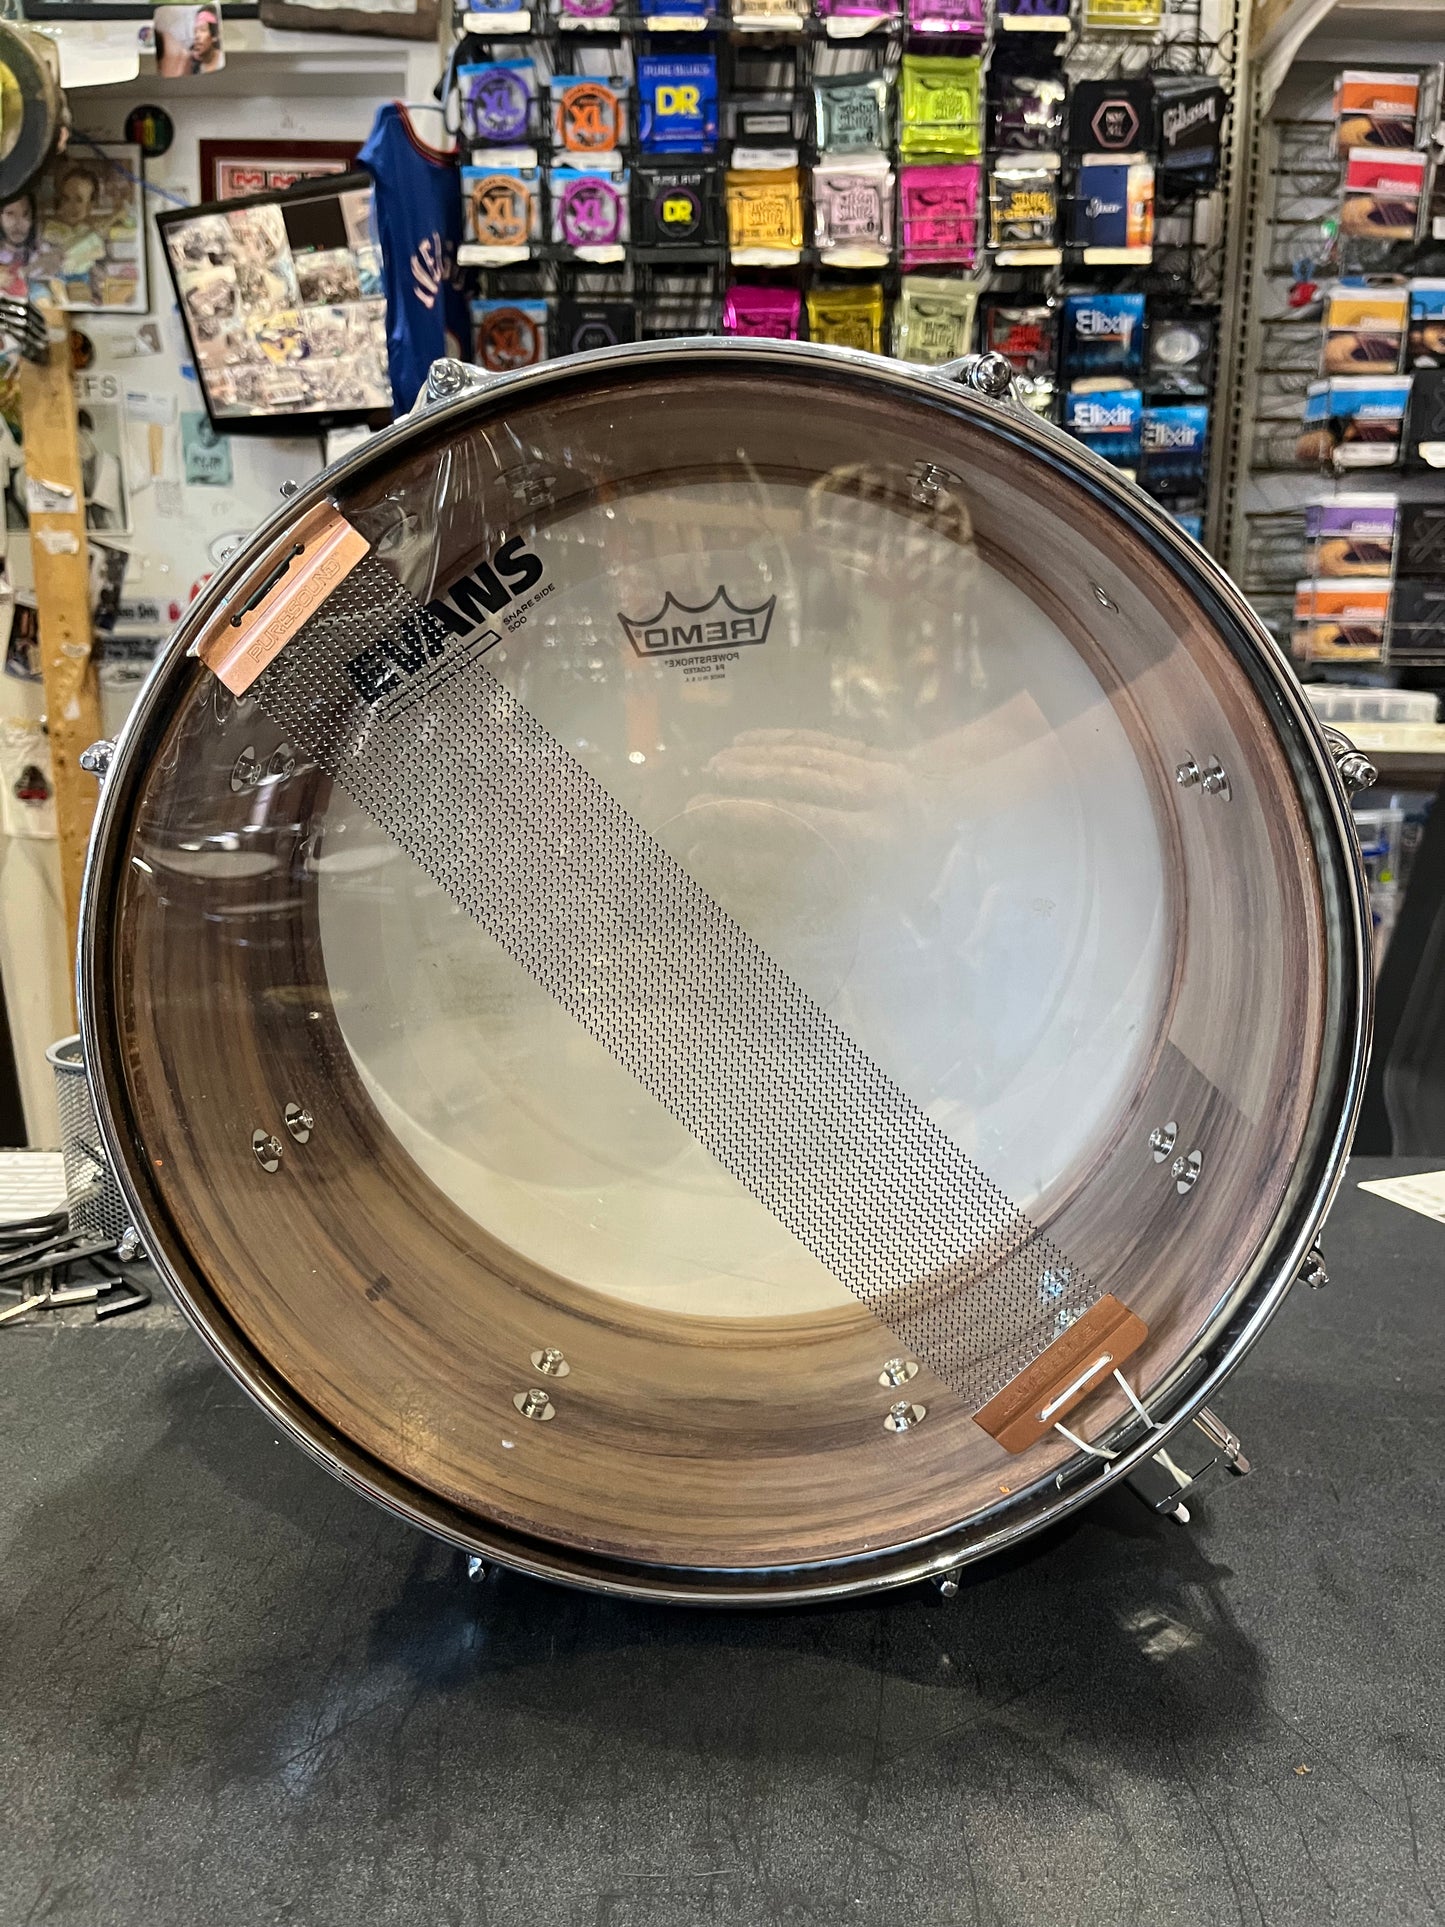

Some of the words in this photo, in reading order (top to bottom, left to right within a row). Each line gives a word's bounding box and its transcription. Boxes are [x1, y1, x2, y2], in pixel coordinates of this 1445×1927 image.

[655, 85, 700, 115] DR
[663, 199, 692, 224] DR
[1075, 309, 1137, 335] Elixir
[1073, 402, 1135, 427] Elixir
[1140, 420, 1200, 448] Elixir
[246, 558, 341, 663] PURESOUND
[502, 599, 534, 626] SNARE
[533, 582, 556, 604] SIDE
[346, 535, 543, 704] EVANS
[507, 616, 528, 633] 500
